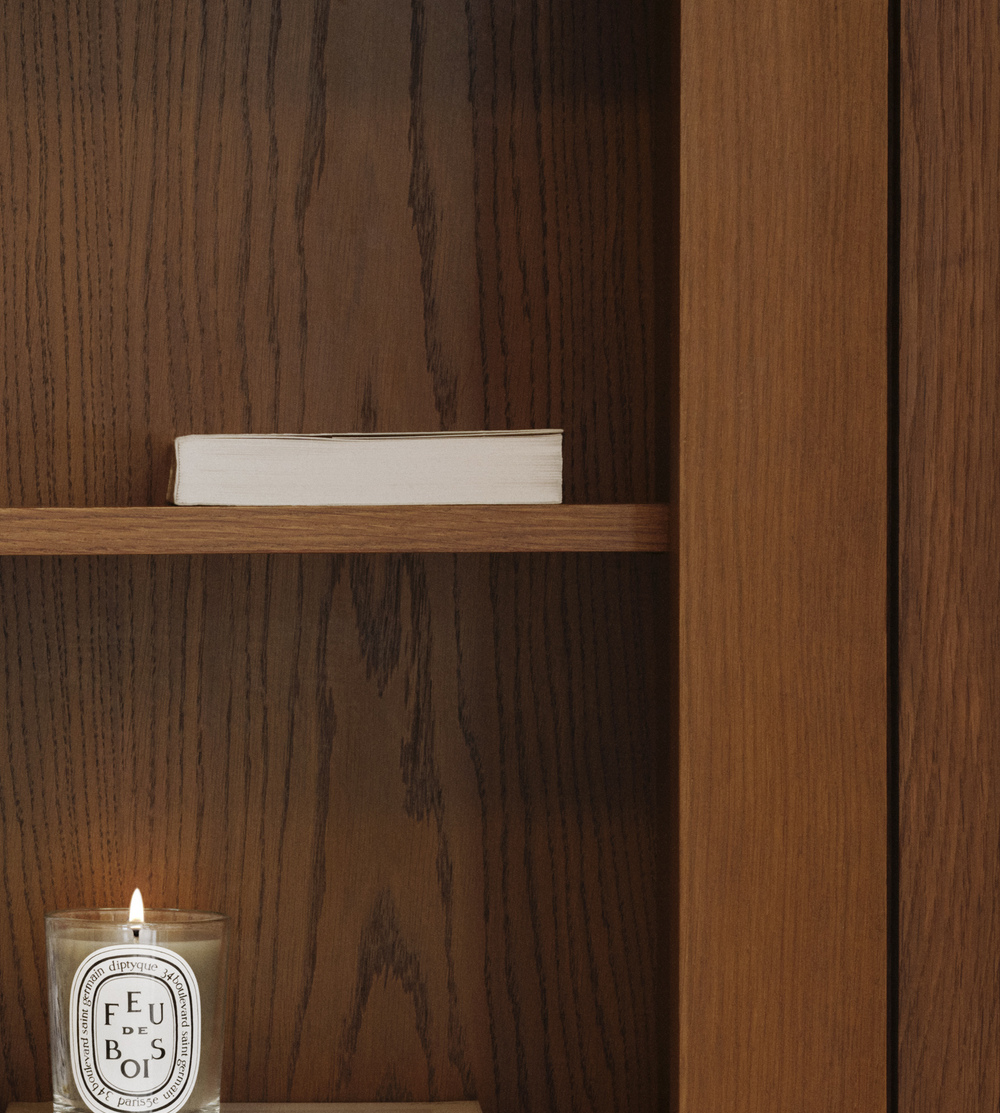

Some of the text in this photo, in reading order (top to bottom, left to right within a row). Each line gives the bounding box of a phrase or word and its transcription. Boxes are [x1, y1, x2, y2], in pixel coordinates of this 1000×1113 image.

[108, 960, 159, 972] diptyque
[104, 991, 164, 1026] FEU
[80, 967, 114, 1102] 34 boulevard saint germain
[122, 1026, 148, 1035] DE
[160, 968, 190, 1100] 34 boulevard saint germain
[104, 1038, 166, 1079] BOIS
